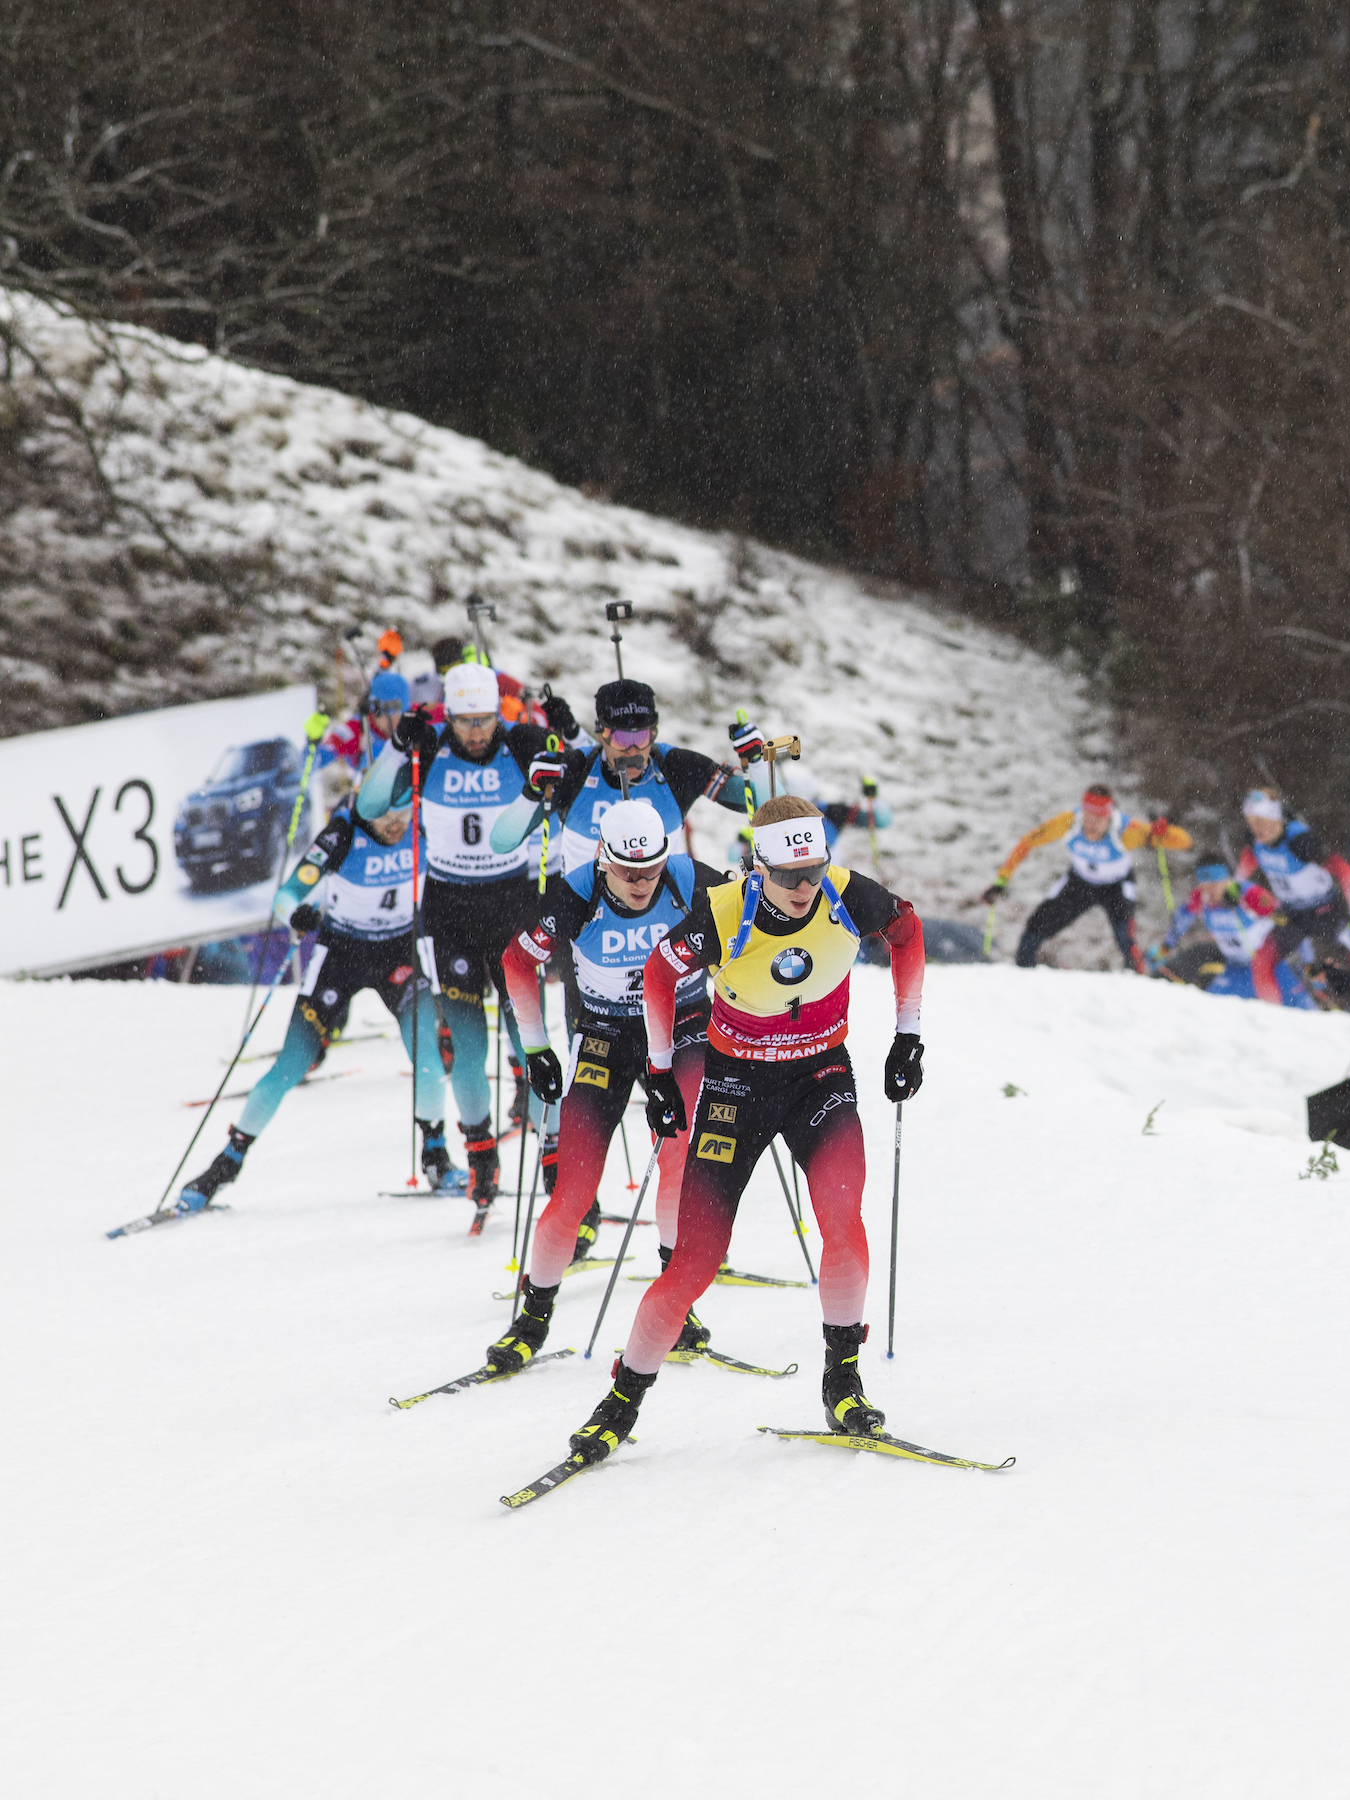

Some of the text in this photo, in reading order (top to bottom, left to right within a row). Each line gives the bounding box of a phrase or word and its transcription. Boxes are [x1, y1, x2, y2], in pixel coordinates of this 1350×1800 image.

[443, 767, 501, 793] DKB
[462, 812, 483, 847] 6
[784, 830, 814, 848] ice
[52, 778, 159, 911] X3
[622, 834, 648, 851] ice
[365, 848, 413, 876] DKB
[379, 888, 398, 911] 4
[521, 936, 545, 958] DNB
[661, 944, 684, 970] DNB
[601, 956, 621, 964] Das
[623, 954, 647, 963] kann
[785, 995, 802, 1022] 1
[706, 1083, 747, 1097] CARGLASS
[849, 1437, 878, 1450] FISCHER
